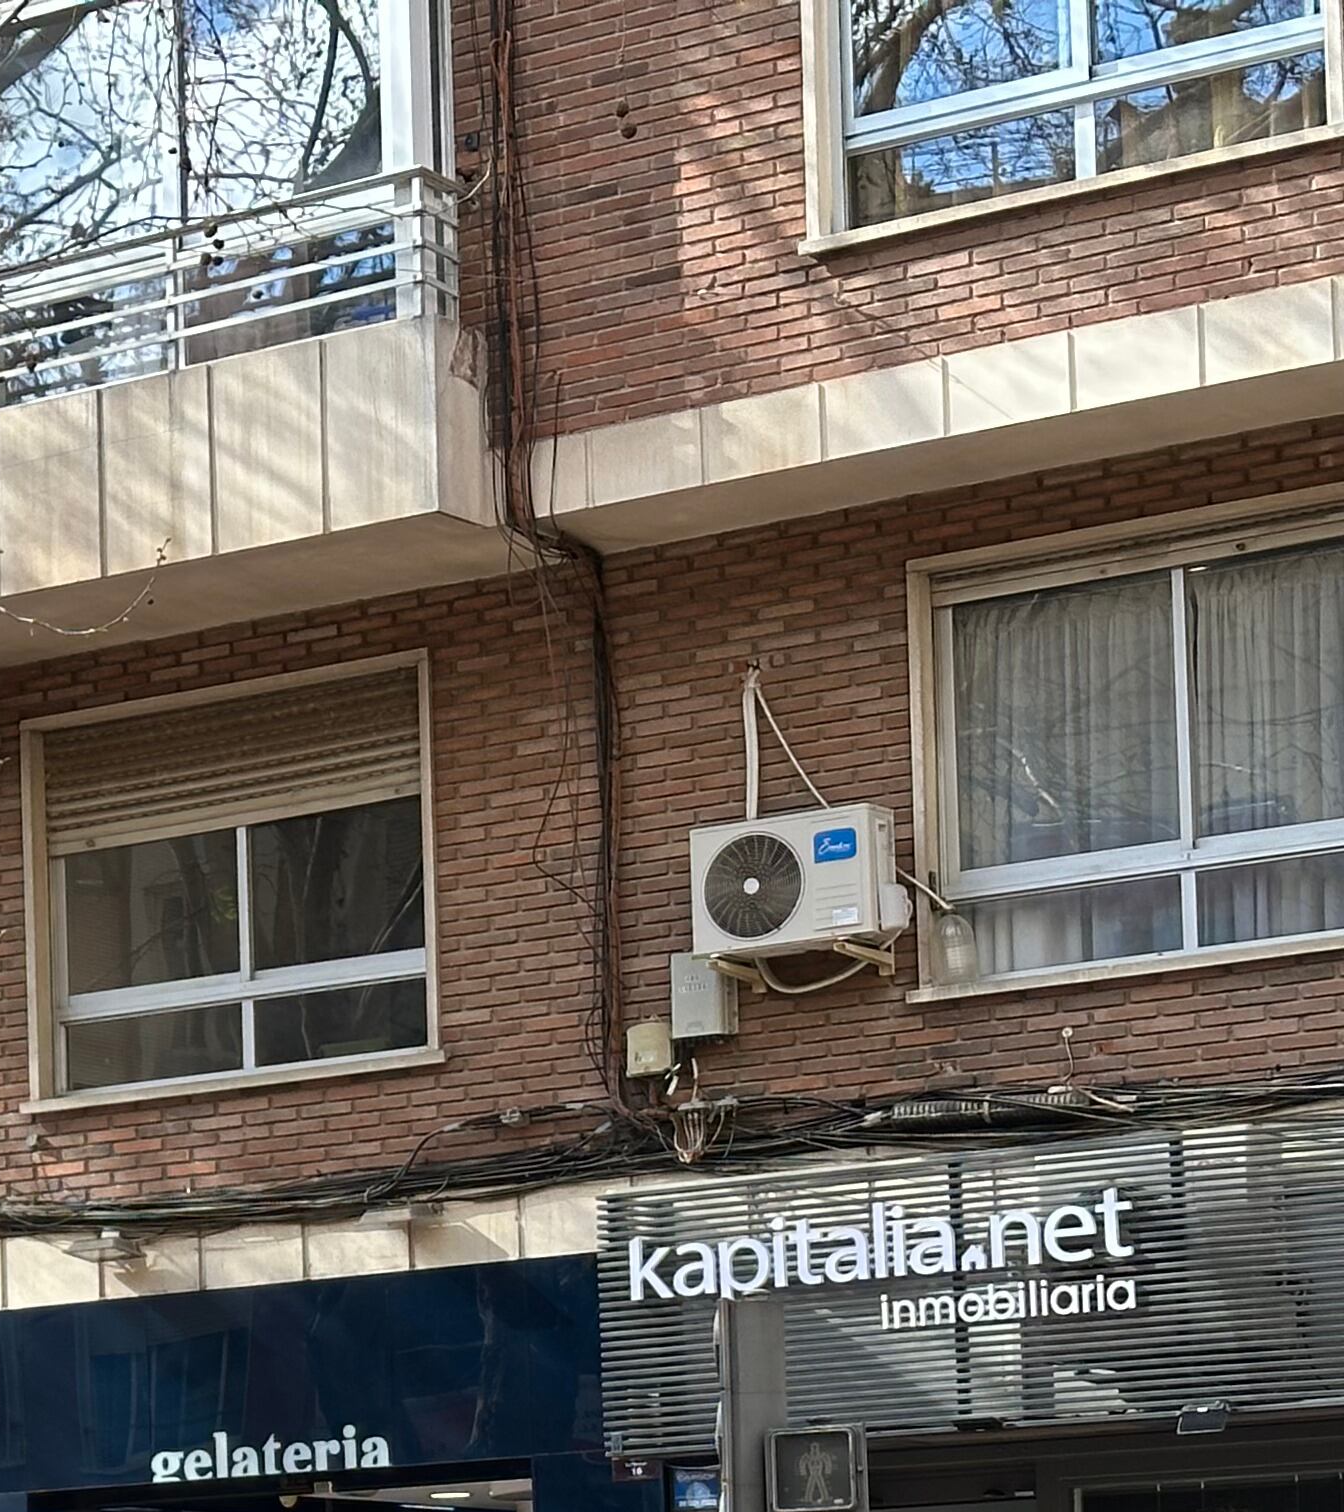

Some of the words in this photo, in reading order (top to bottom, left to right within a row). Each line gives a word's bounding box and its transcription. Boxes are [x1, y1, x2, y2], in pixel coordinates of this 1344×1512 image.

[628, 1186, 1134, 1299] kapitalia.net
[880, 1274, 1137, 1330] inmobiliaria
[150, 1424, 392, 1483] gelateria
